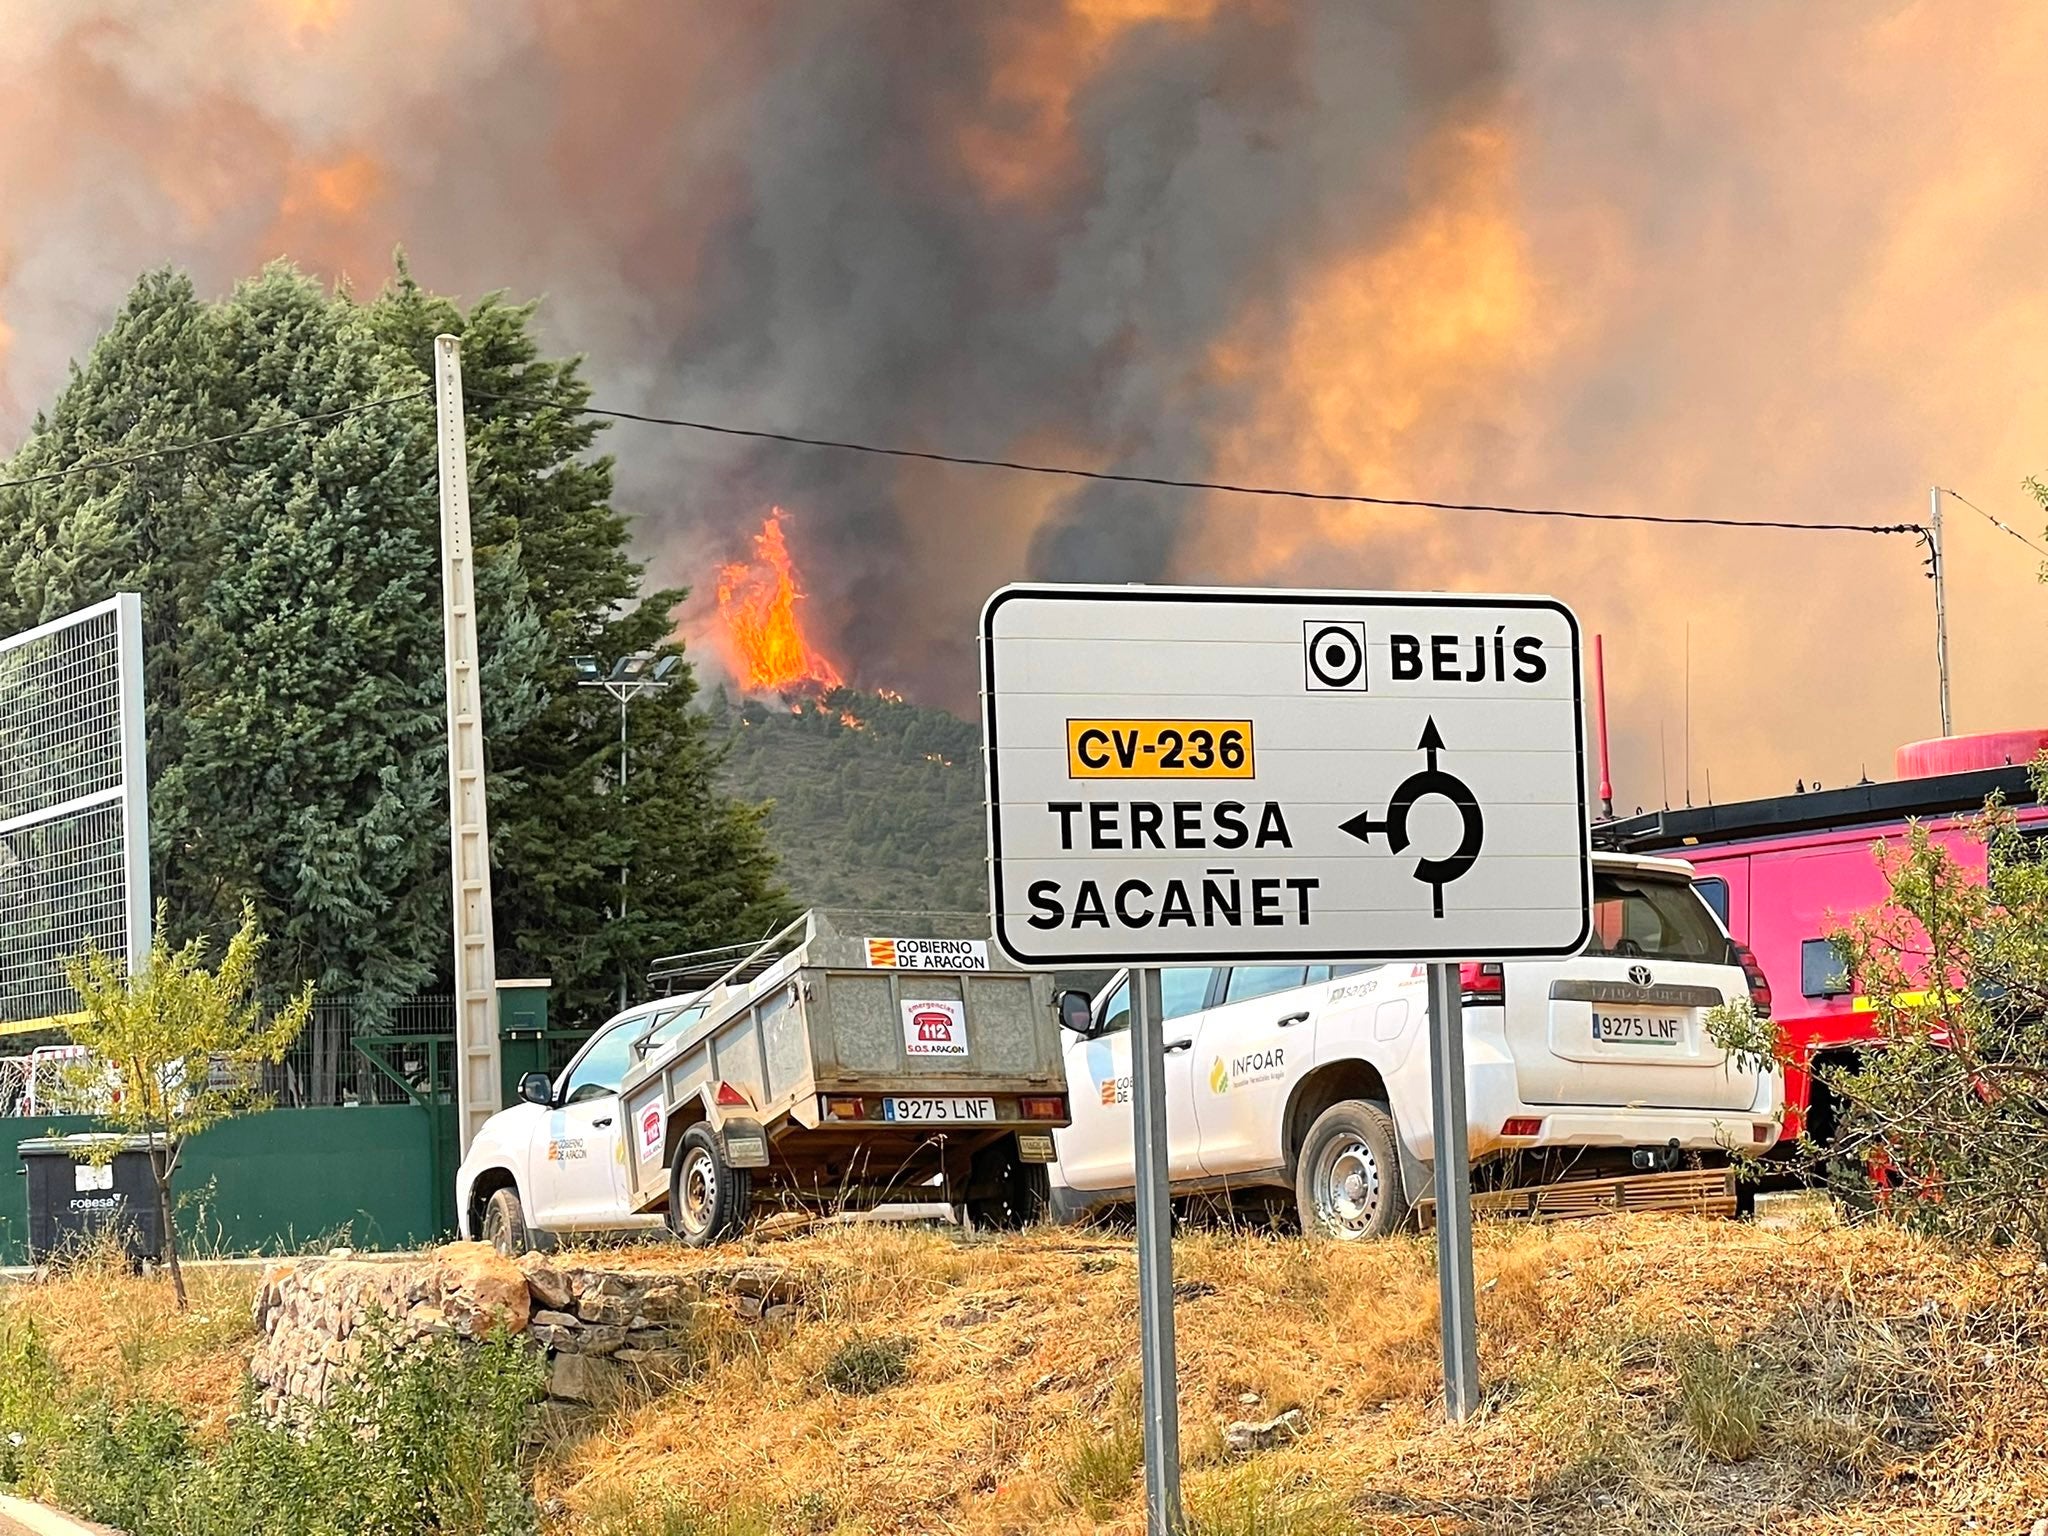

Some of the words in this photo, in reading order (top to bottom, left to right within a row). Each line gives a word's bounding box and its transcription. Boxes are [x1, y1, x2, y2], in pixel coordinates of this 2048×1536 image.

[1390, 625, 1547, 683] BEJÍS
[1077, 729, 1245, 769] CV-236
[1047, 801, 1293, 850] TERESA
[1026, 868, 1320, 930] SACAÑET
[896, 940, 973, 955] GOBIERNO
[898, 955, 918, 968] DE
[923, 955, 986, 969] ARAGON
[922, 1023, 947, 1040] 112
[1602, 1017, 1644, 1036] 9275
[1648, 1019, 1678, 1038] LNF
[1232, 1048, 1285, 1077] INFOAR
[1116, 1091, 1129, 1104] DE
[897, 1100, 947, 1119] 9275
[952, 1100, 989, 1119] LNF
